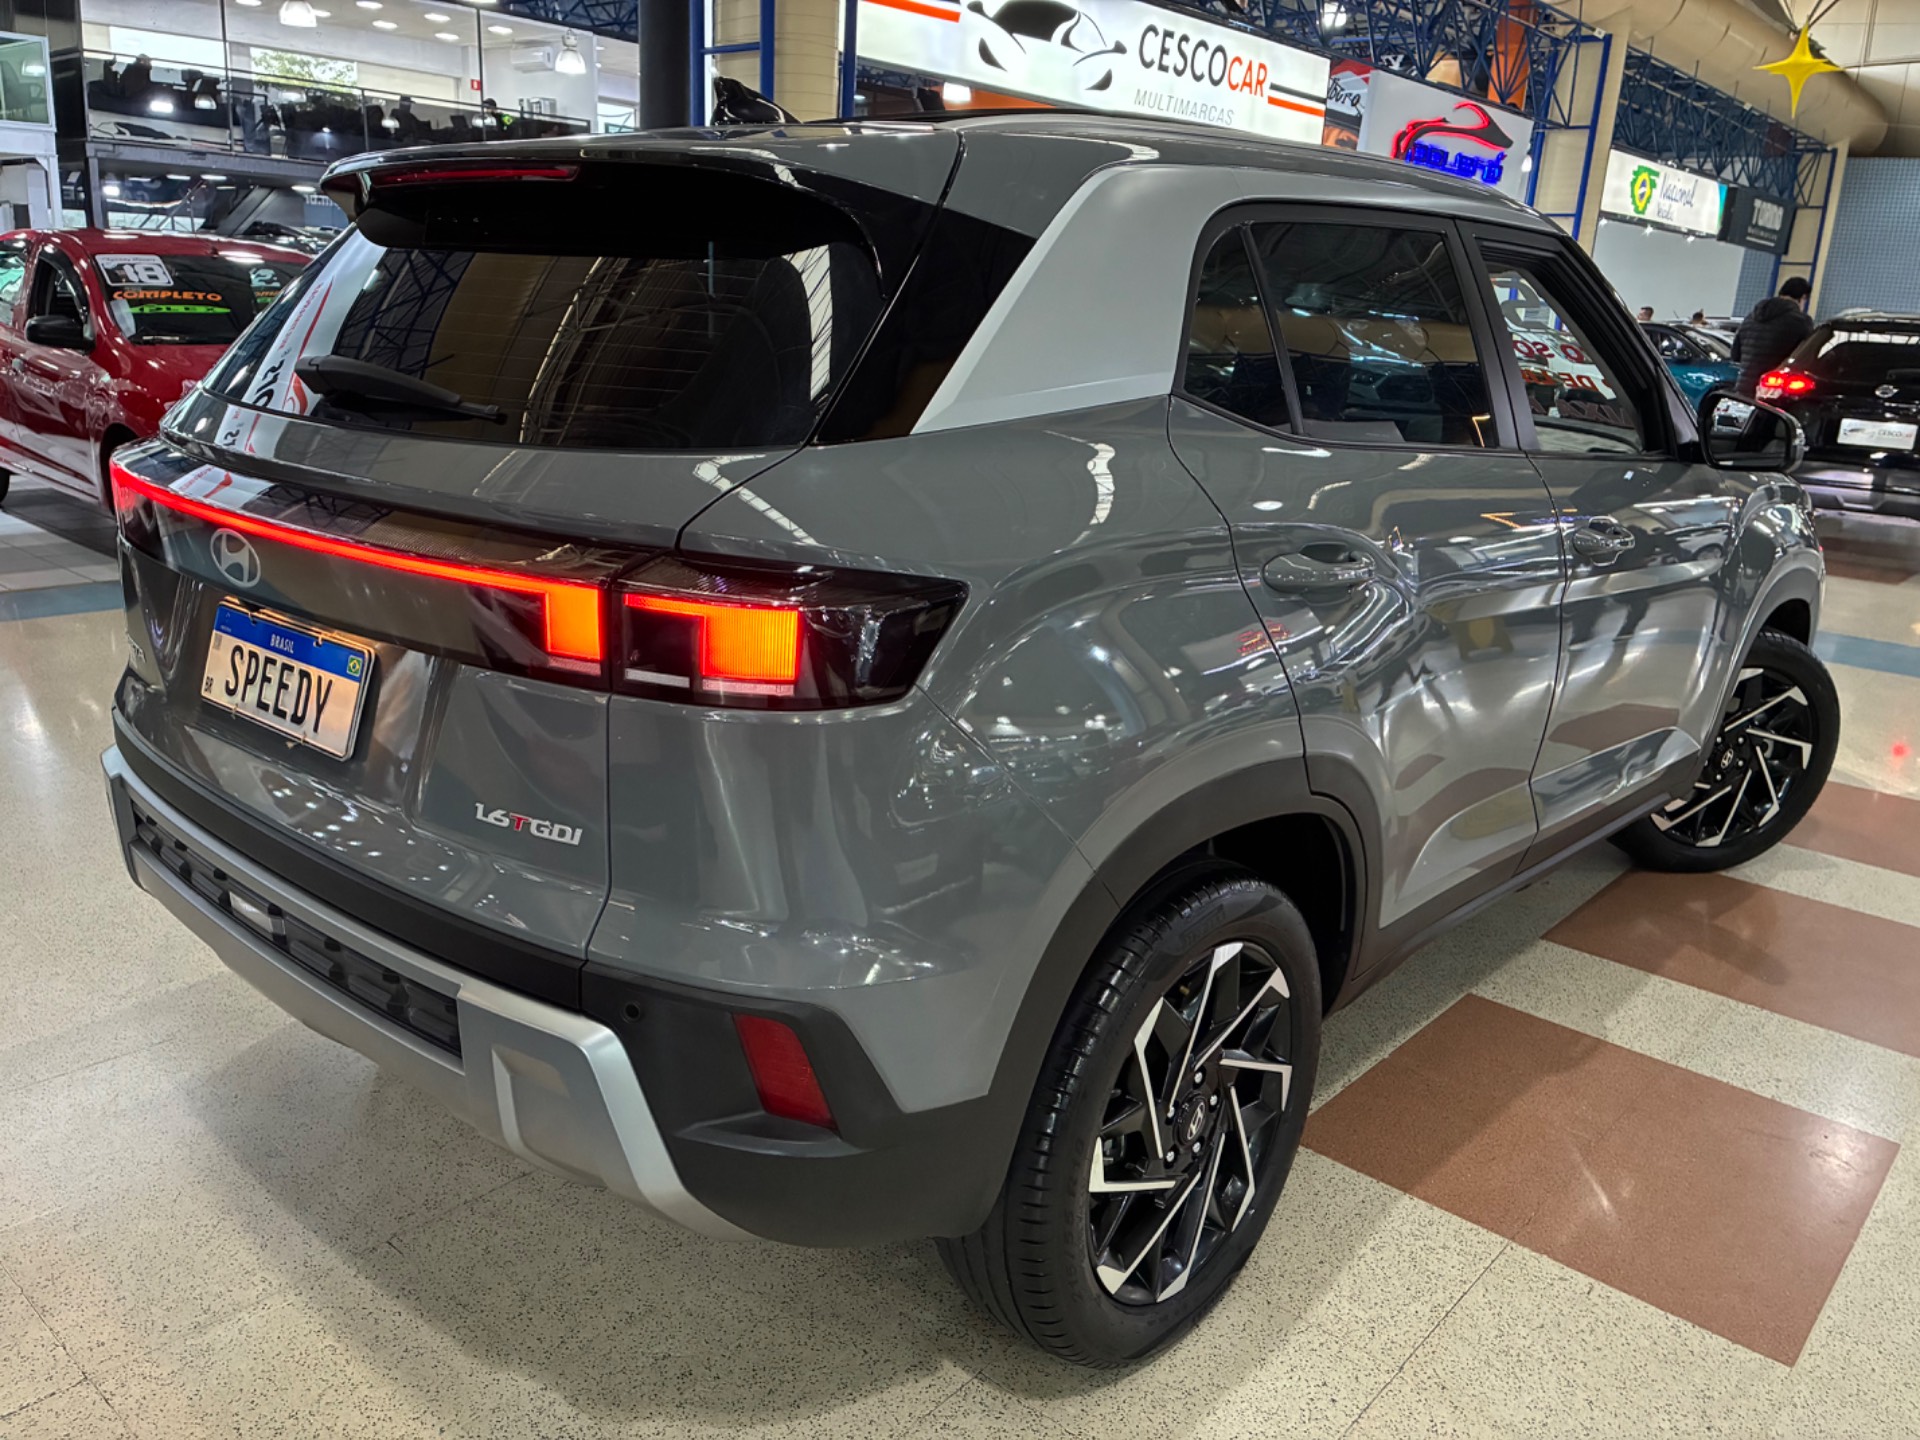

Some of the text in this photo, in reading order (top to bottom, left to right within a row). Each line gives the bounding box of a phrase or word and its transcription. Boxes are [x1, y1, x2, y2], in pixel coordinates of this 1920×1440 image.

[1139, 24, 1268, 97] CESCOCAR
[1133, 88, 1234, 126] MULTIMARCAS
[113, 291, 222, 301] COMPLETO
[270, 633, 294, 654] BRASIL
[224, 644, 333, 733] SPEEDY
